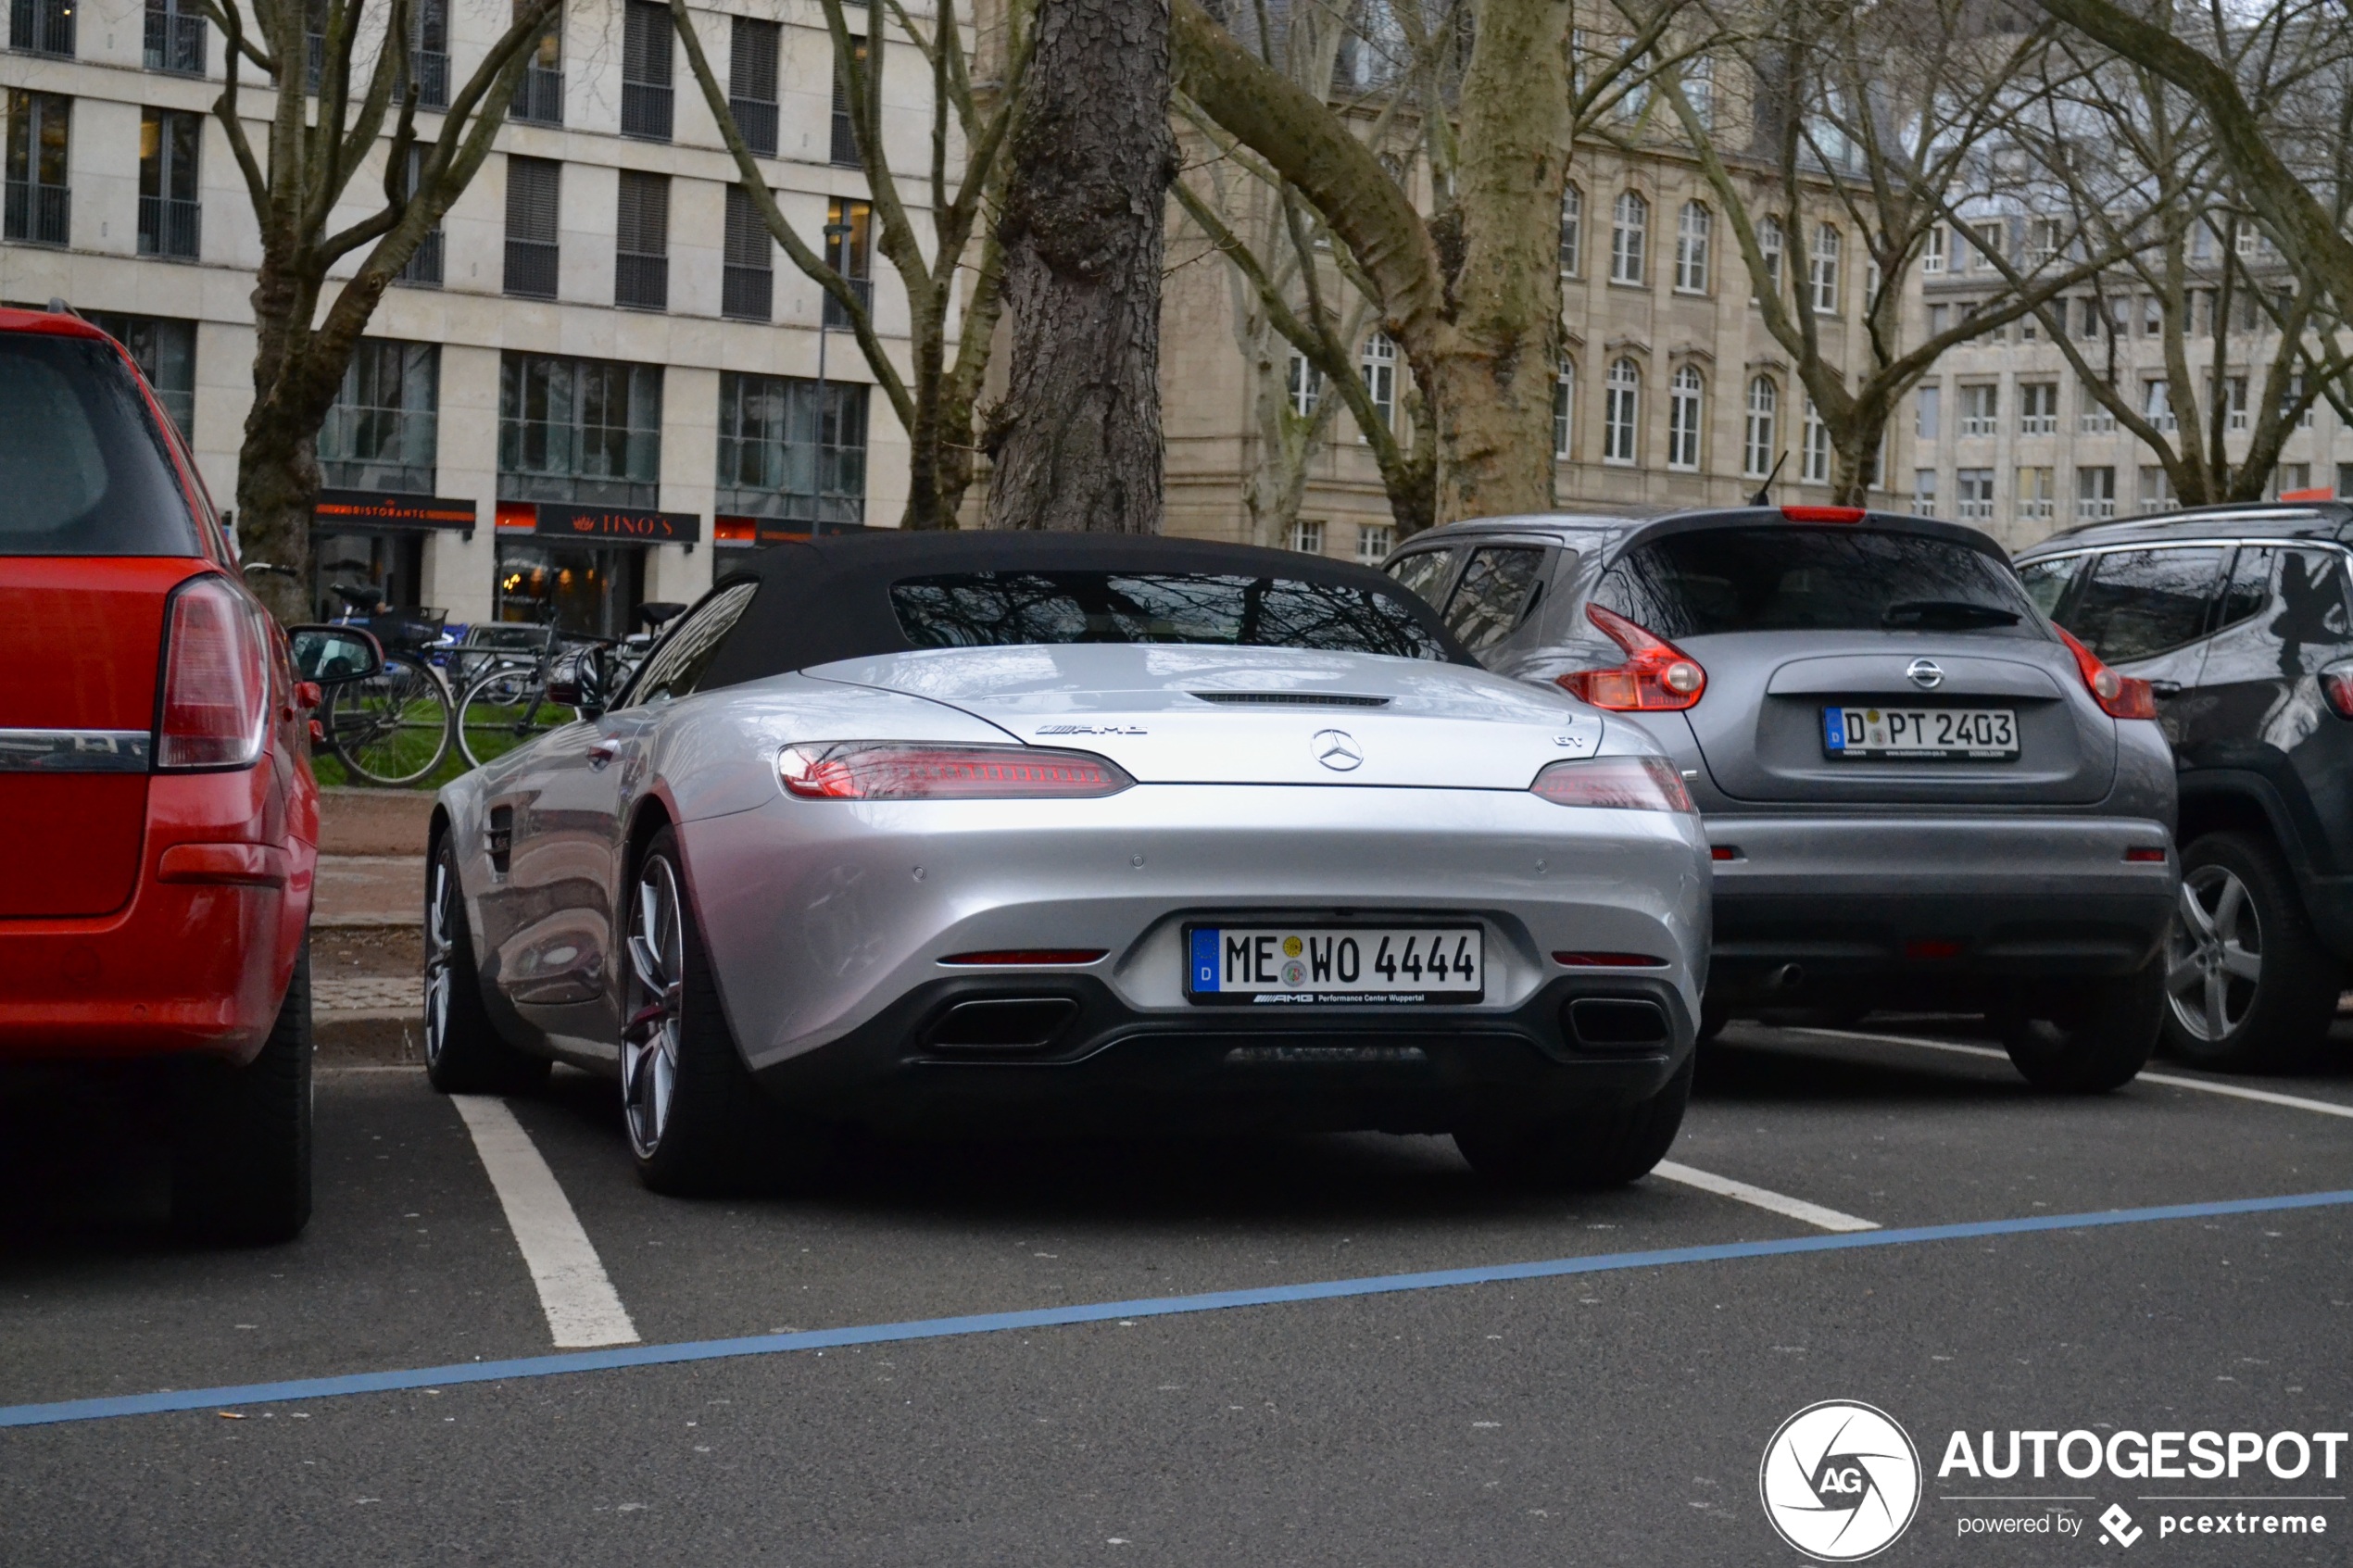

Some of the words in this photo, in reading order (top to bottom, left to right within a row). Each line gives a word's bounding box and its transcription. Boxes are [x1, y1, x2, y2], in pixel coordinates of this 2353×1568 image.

[353, 505, 425, 520] RISTORANTE
[1072, 724, 1148, 734] AMG
[1844, 712, 1866, 745] D
[1886, 713, 1926, 745] PT
[1935, 713, 2012, 746] 2403
[1226, 935, 1278, 983] ME
[1309, 935, 1360, 983] WO
[1374, 935, 1475, 982] 4444
[1201, 967, 1212, 981] D
[1274, 994, 1314, 1003] AMG
[1318, 994, 1363, 1003] Performance
[1364, 994, 1388, 1003] Center
[1389, 994, 1425, 1003] Wuppertal
